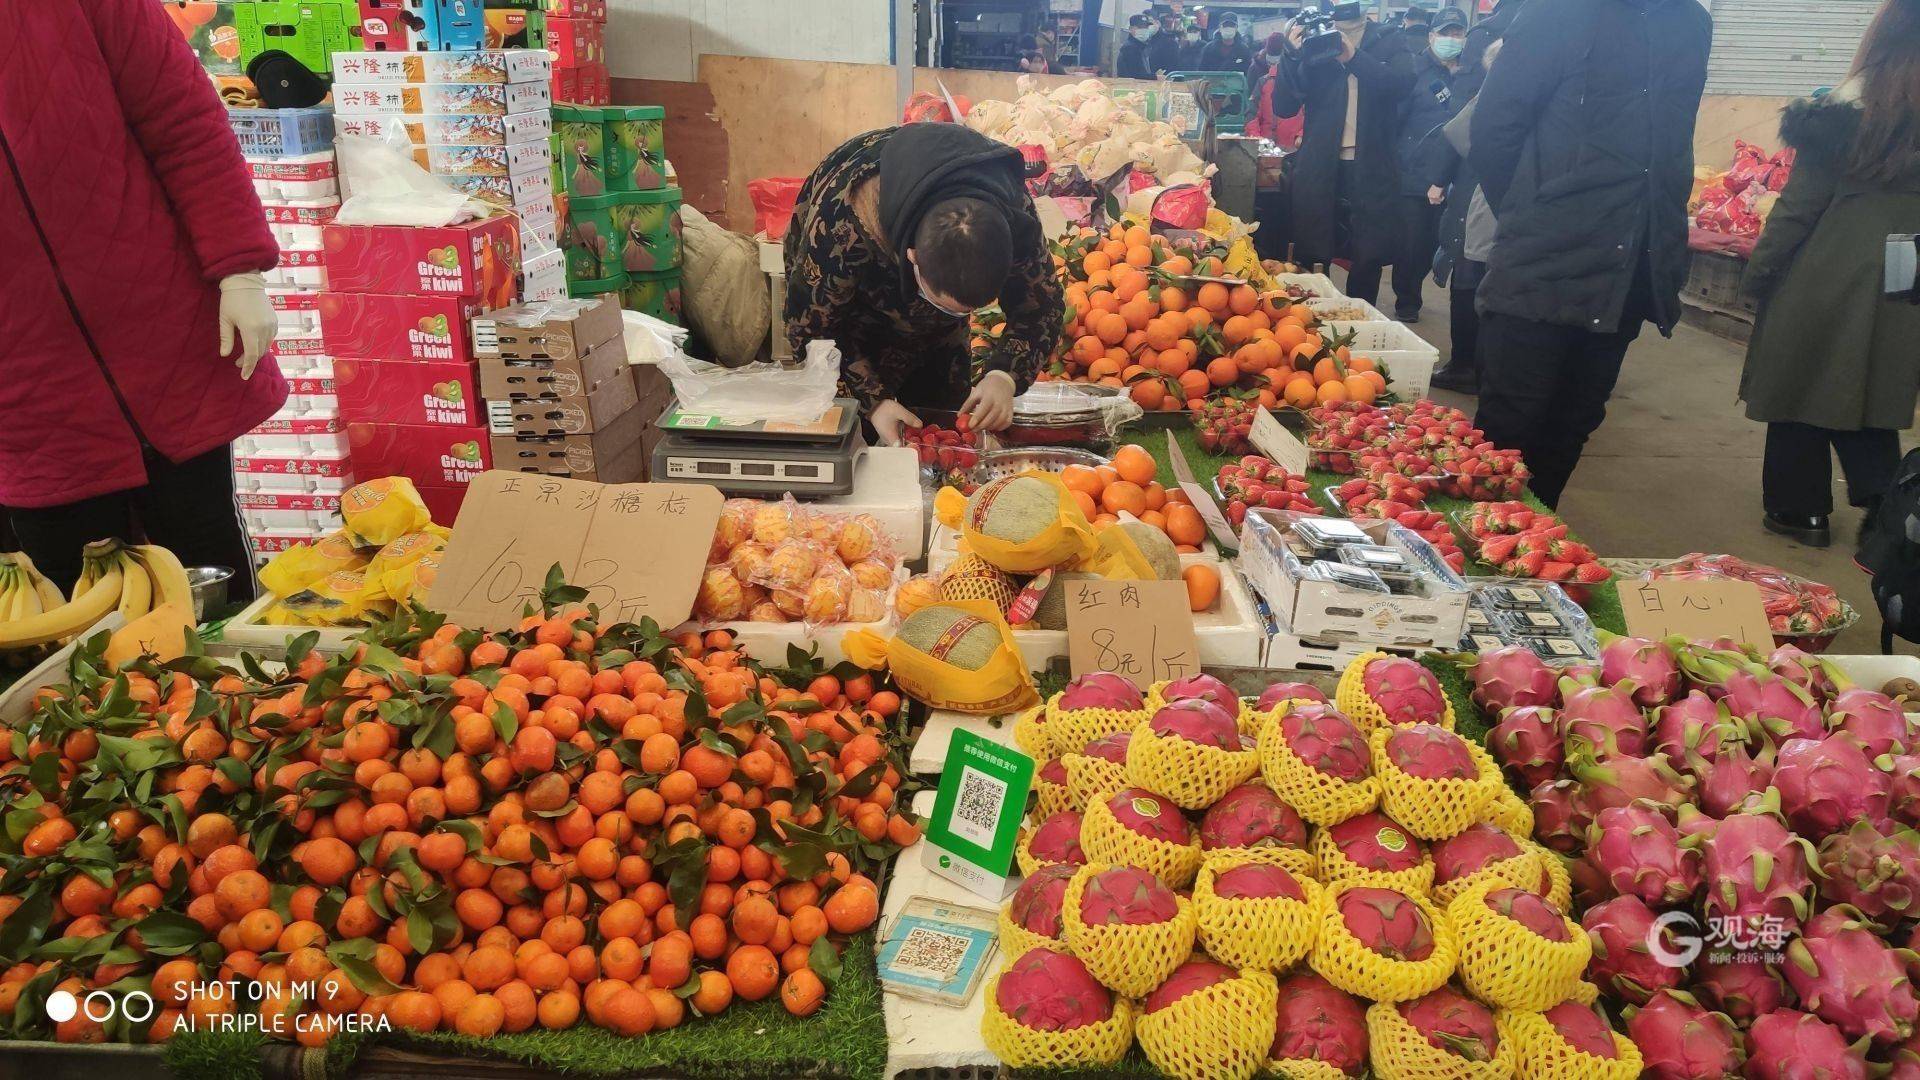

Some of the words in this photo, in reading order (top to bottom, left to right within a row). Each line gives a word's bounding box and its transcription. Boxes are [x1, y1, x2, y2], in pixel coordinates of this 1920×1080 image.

[417, 261, 462, 277] Green
[433, 277, 464, 292] kiwi
[408, 328, 452, 345] Green
[423, 344, 454, 360] kiwi
[423, 394, 466, 410] Green
[437, 410, 467, 424] kiwi
[440, 454, 484, 470] Green
[1078, 583, 1141, 612] 红肉
